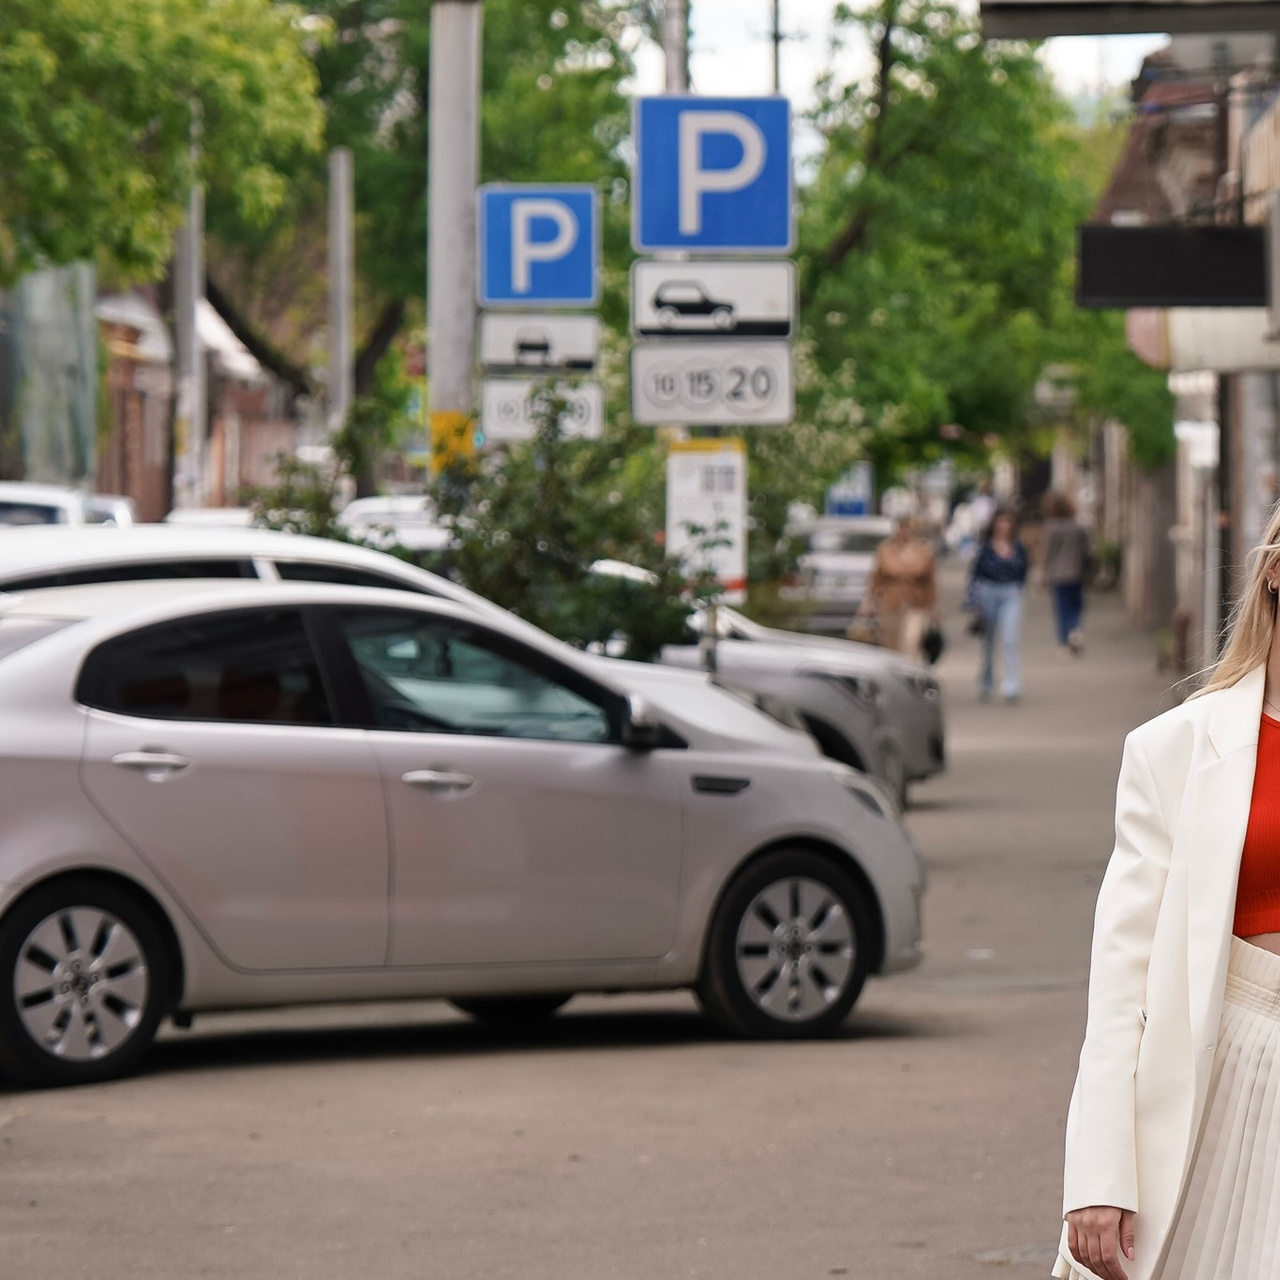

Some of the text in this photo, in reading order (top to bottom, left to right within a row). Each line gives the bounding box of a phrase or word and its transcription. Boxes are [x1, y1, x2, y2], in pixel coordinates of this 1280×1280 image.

[679, 110, 767, 236] P
[511, 199, 579, 293] P
[654, 366, 772, 401] 10 15 20
